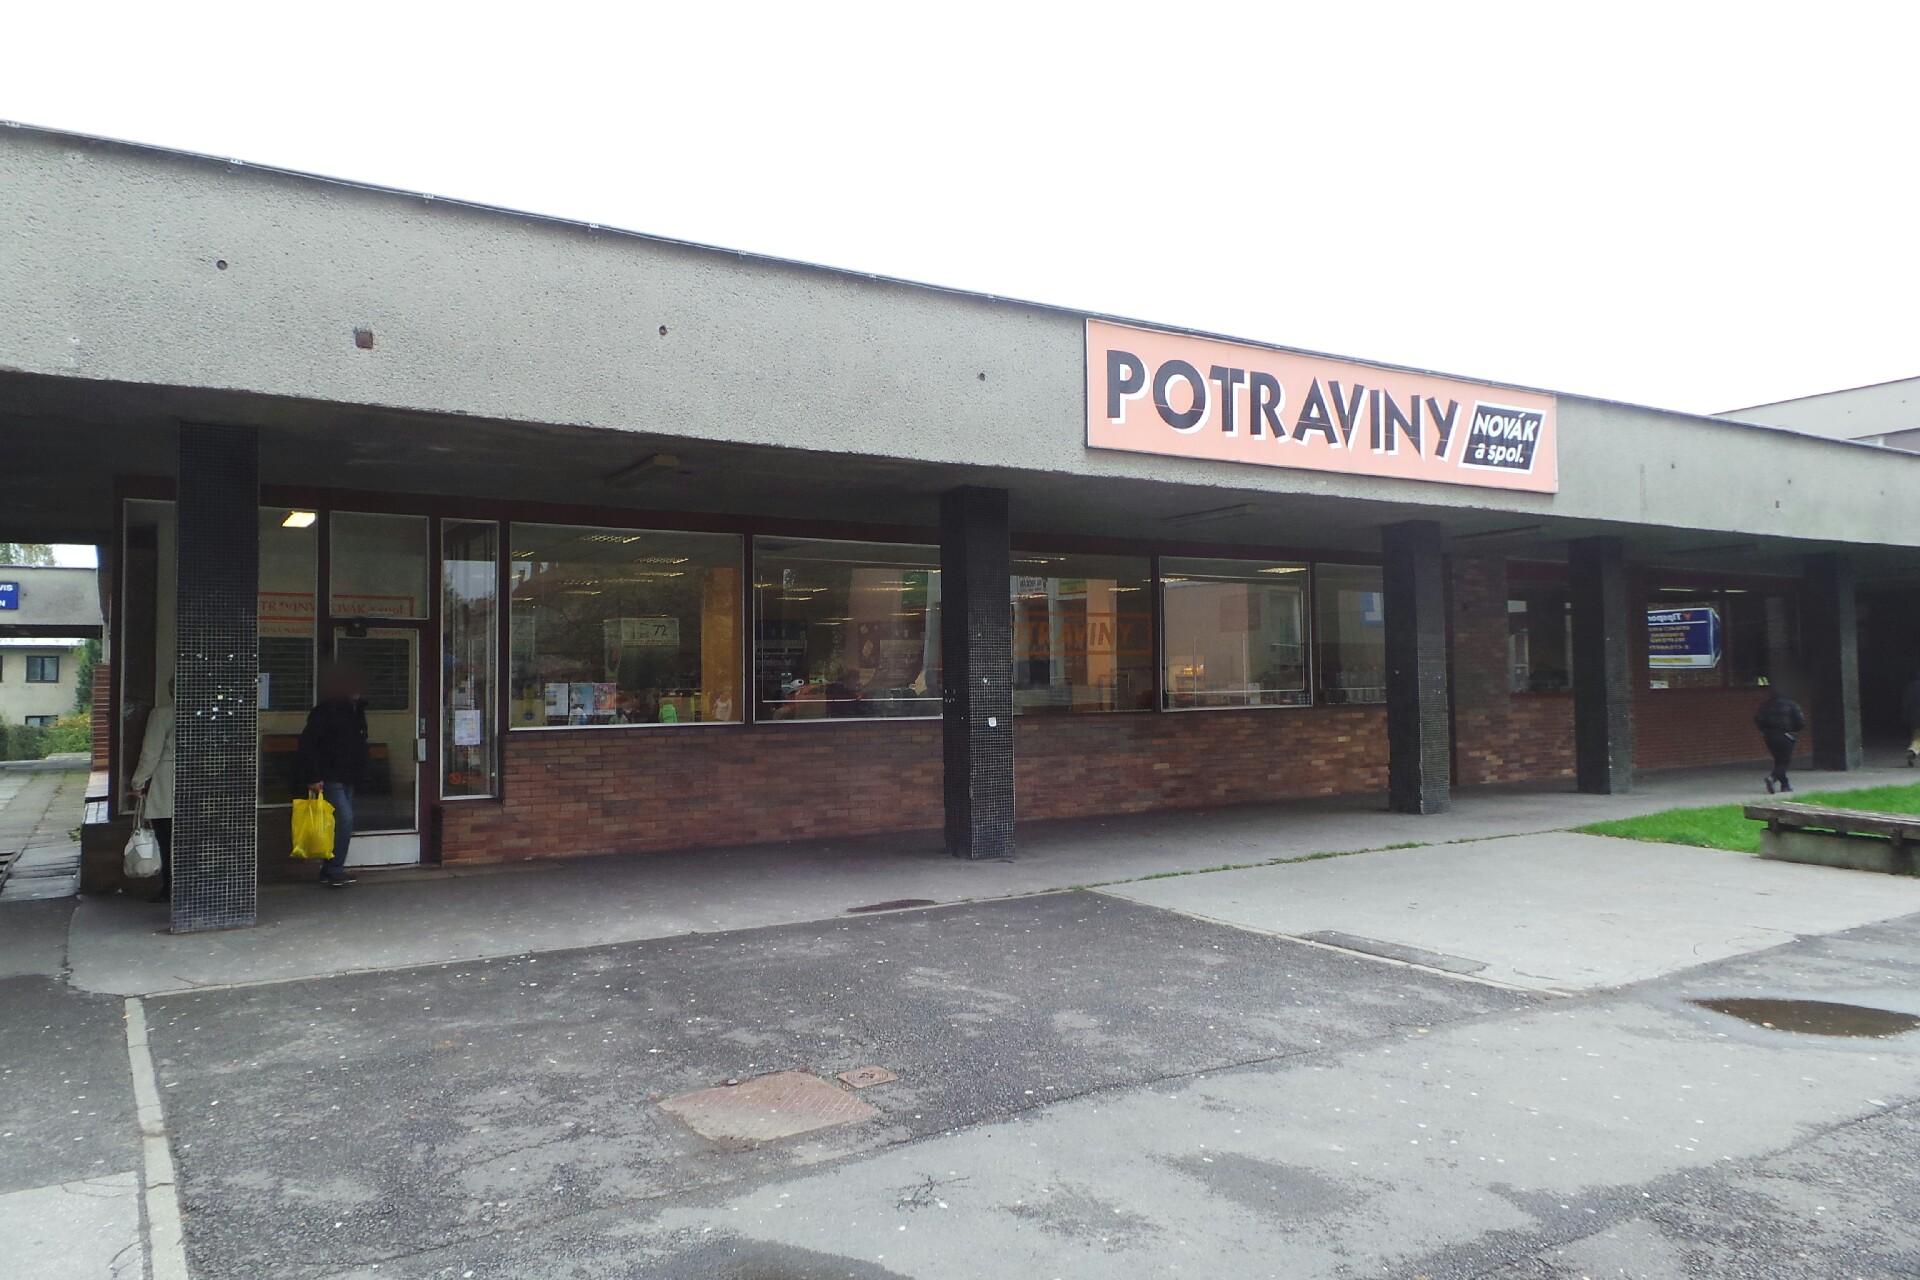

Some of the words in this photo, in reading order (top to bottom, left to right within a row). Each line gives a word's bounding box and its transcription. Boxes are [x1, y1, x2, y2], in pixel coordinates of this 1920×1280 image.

[1106, 349, 1460, 459] POTRAVINY
[1473, 412, 1538, 441] NOVÁK
[1475, 443, 1486, 459] a
[1487, 444, 1524, 464] spol.
